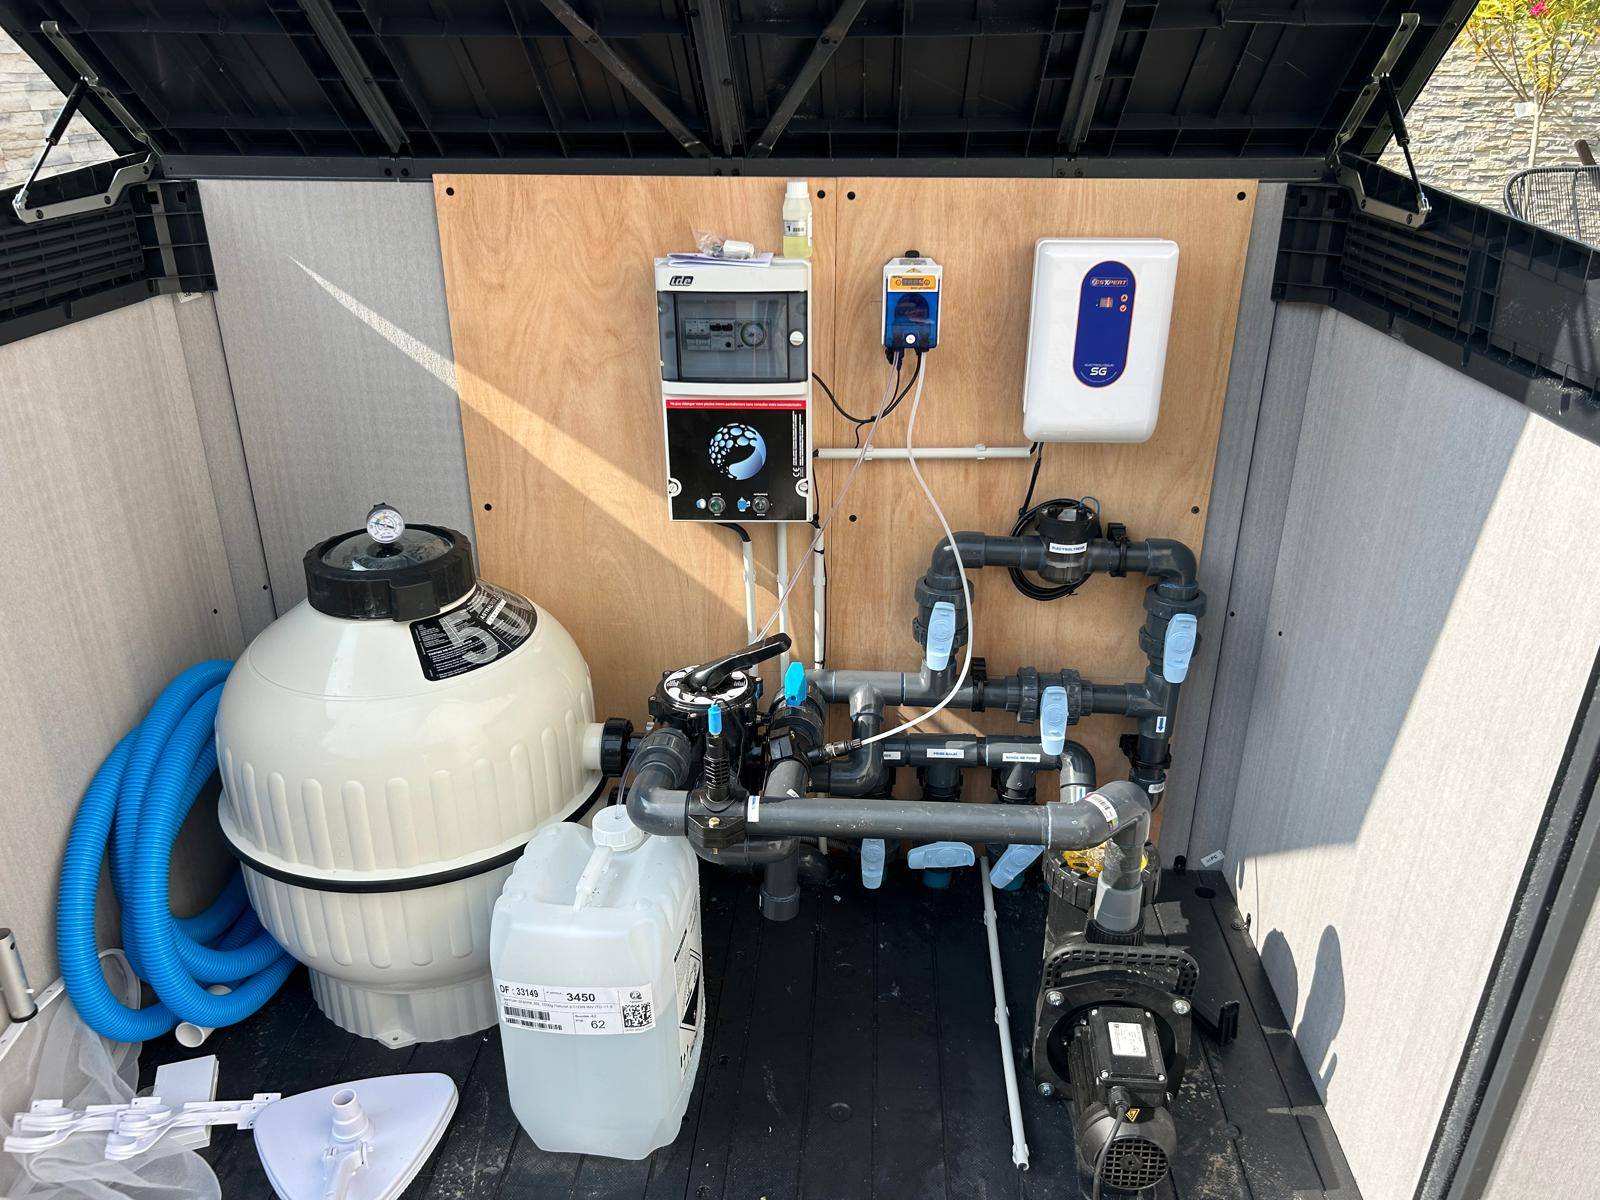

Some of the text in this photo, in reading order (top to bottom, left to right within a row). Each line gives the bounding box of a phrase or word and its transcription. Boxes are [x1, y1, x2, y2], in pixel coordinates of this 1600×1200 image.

[1090, 367, 1107, 376] SG
[500, 985, 509, 993] OF
[516, 987, 539, 997] 33149
[566, 992, 596, 1002] 3450
[591, 1020, 606, 1029] 62
